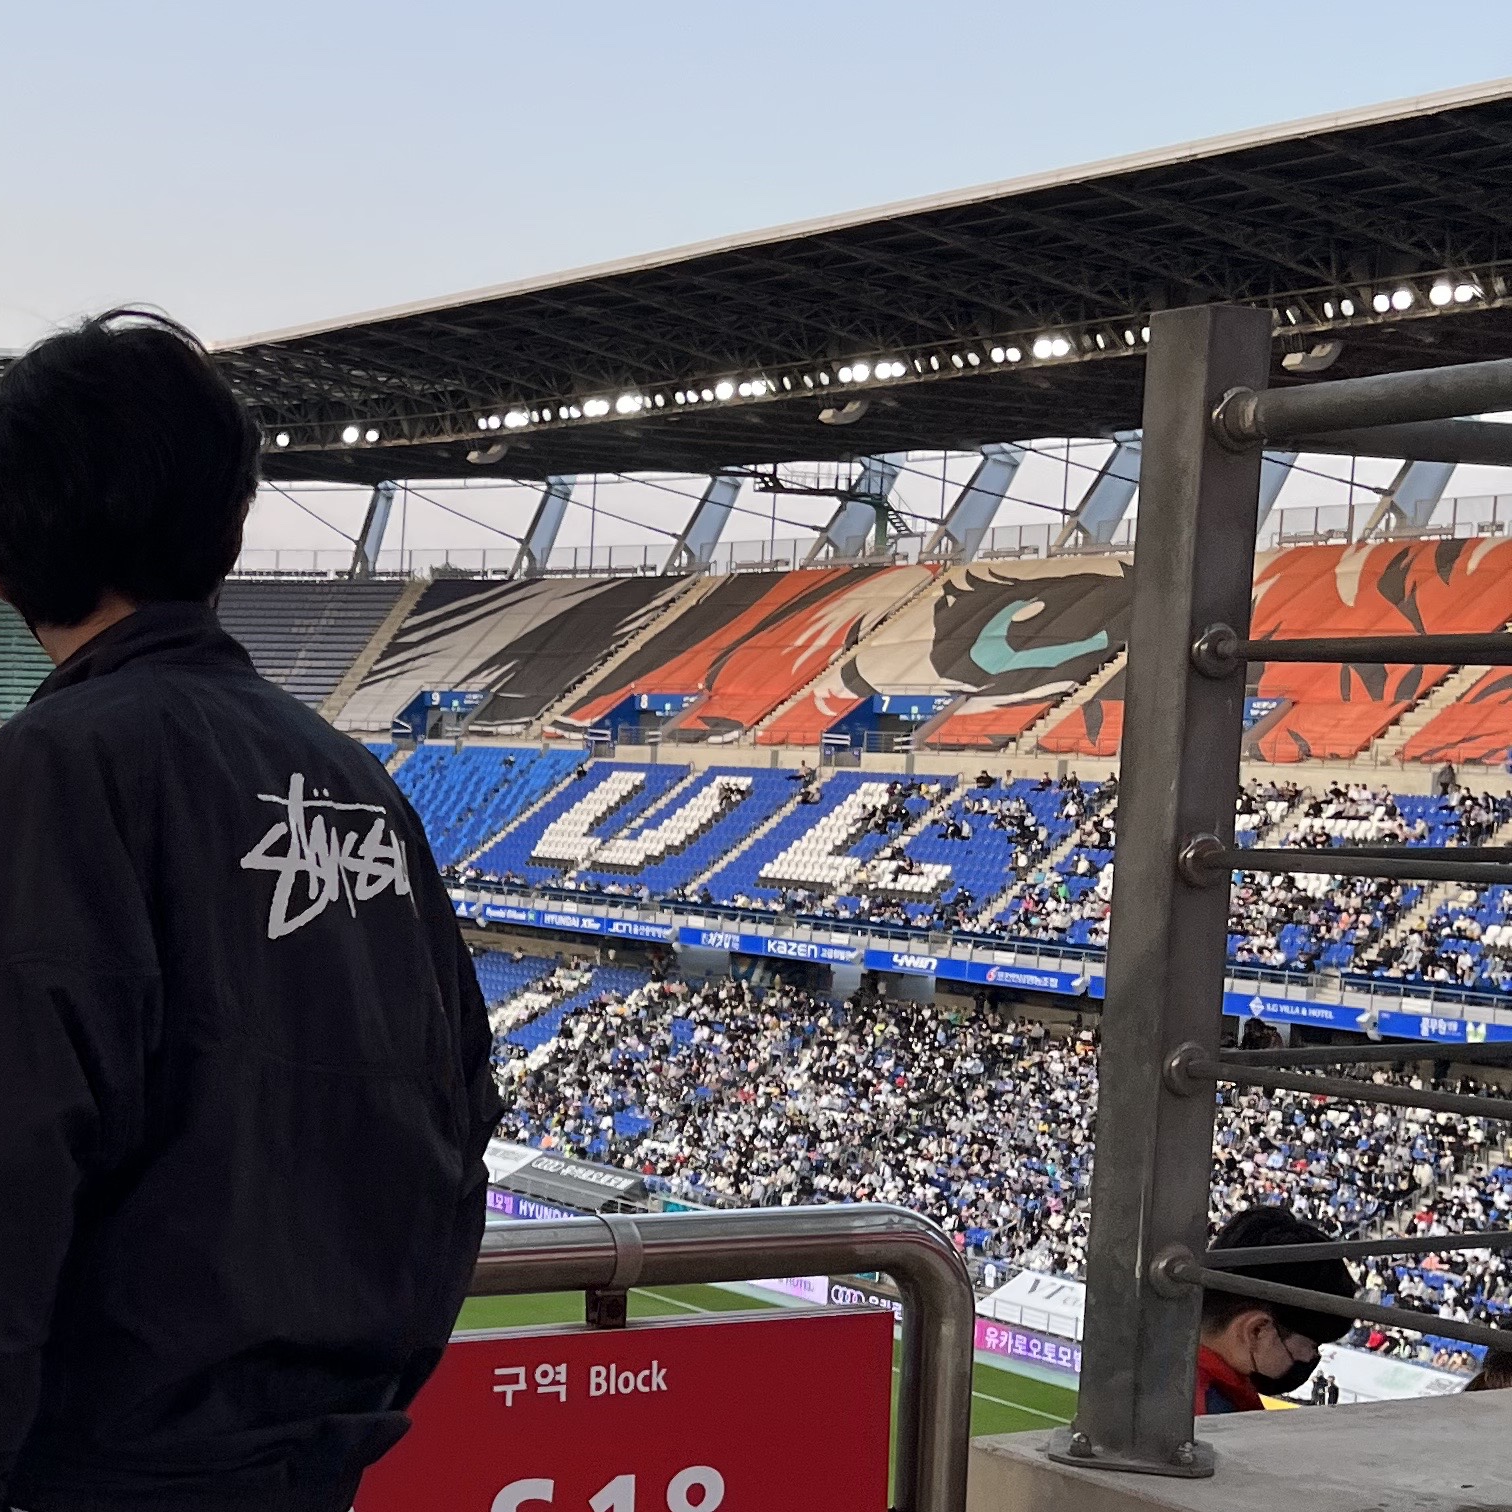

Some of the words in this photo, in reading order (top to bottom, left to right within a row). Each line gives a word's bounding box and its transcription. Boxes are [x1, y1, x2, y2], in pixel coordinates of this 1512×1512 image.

[431, 691, 441, 706] 9
[881, 695, 891, 713] 7
[493, 1363, 568, 1407] 구역
[589, 1360, 668, 1397] Block
